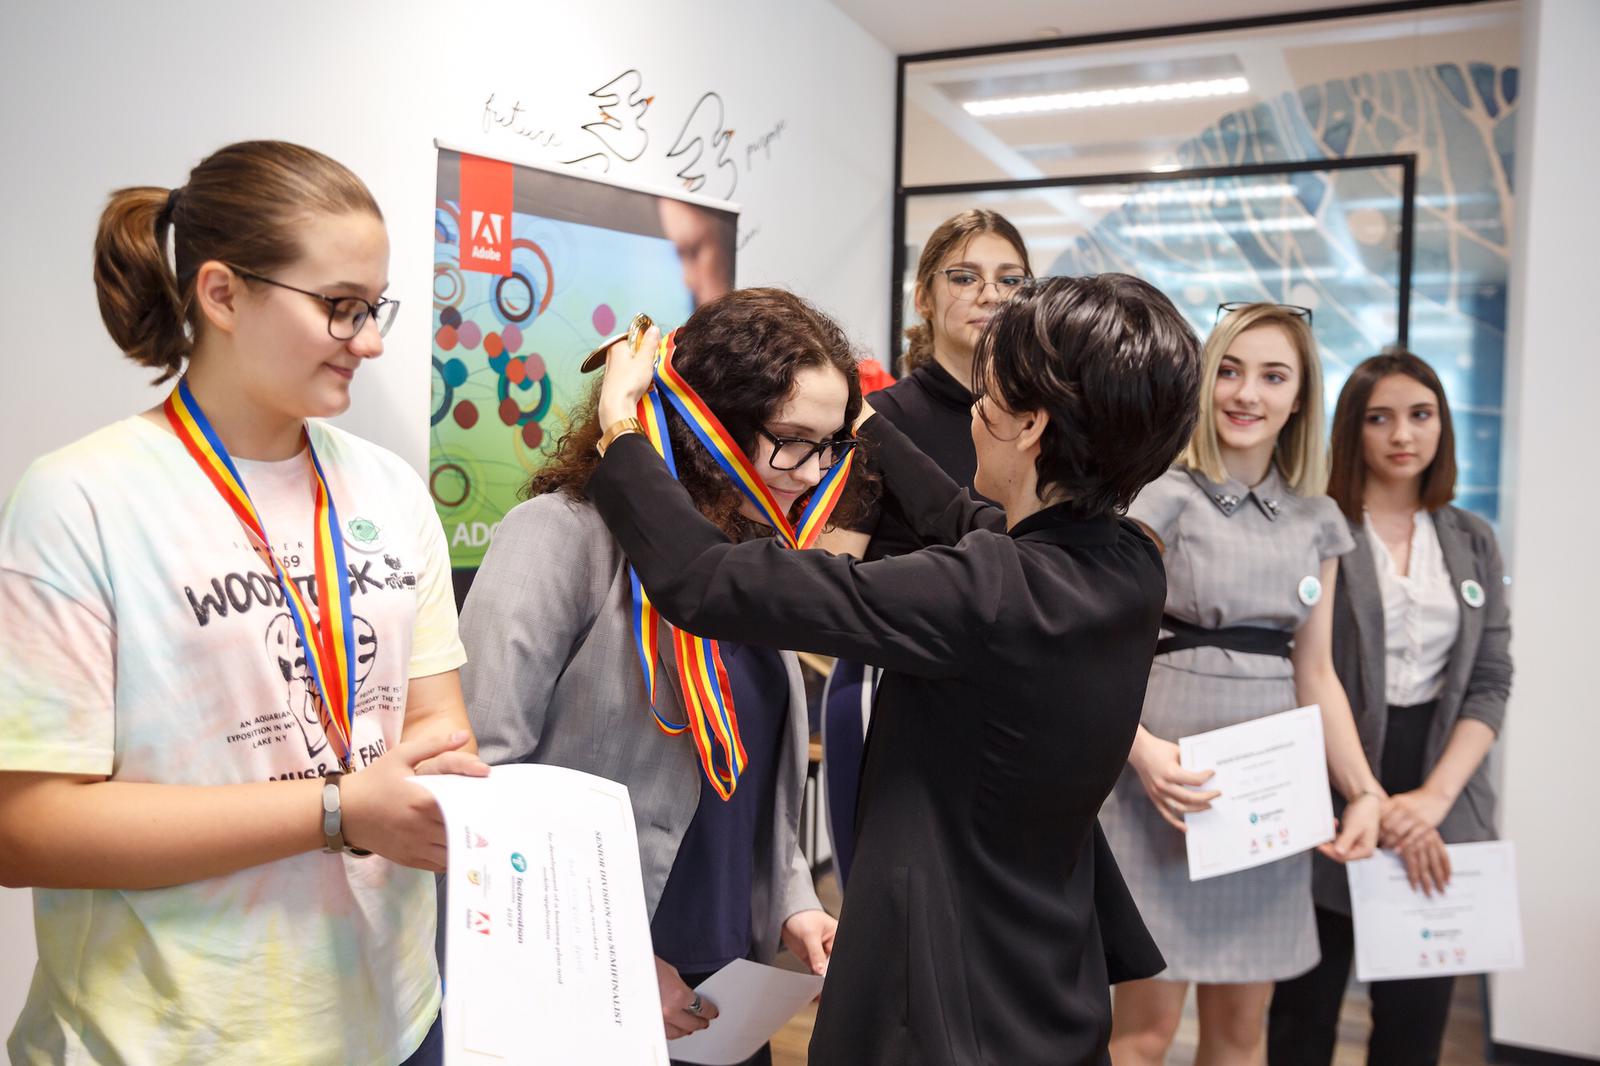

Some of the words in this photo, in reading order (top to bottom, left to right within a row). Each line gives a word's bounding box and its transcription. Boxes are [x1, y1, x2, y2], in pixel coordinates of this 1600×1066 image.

[482, 92, 563, 148] future
[471, 245, 502, 262] Adobe
[378, 703, 390, 711] THE
[382, 694, 394, 702] THE
[226, 725, 272, 744] EXPOSITION
[273, 724, 282, 732] IN
[240, 719, 252, 728] AN
[252, 736, 273, 749] LAKE
[595, 830, 607, 868] SENIOR
[548, 843, 559, 892] development
[599, 869, 613, 918] DIVISION
[516, 876, 525, 945] Technovation
[555, 910, 563, 946] business
[606, 919, 614, 942] 2019
[554, 947, 564, 967] plan
[608, 943, 623, 1028] SEMIFINALIST
